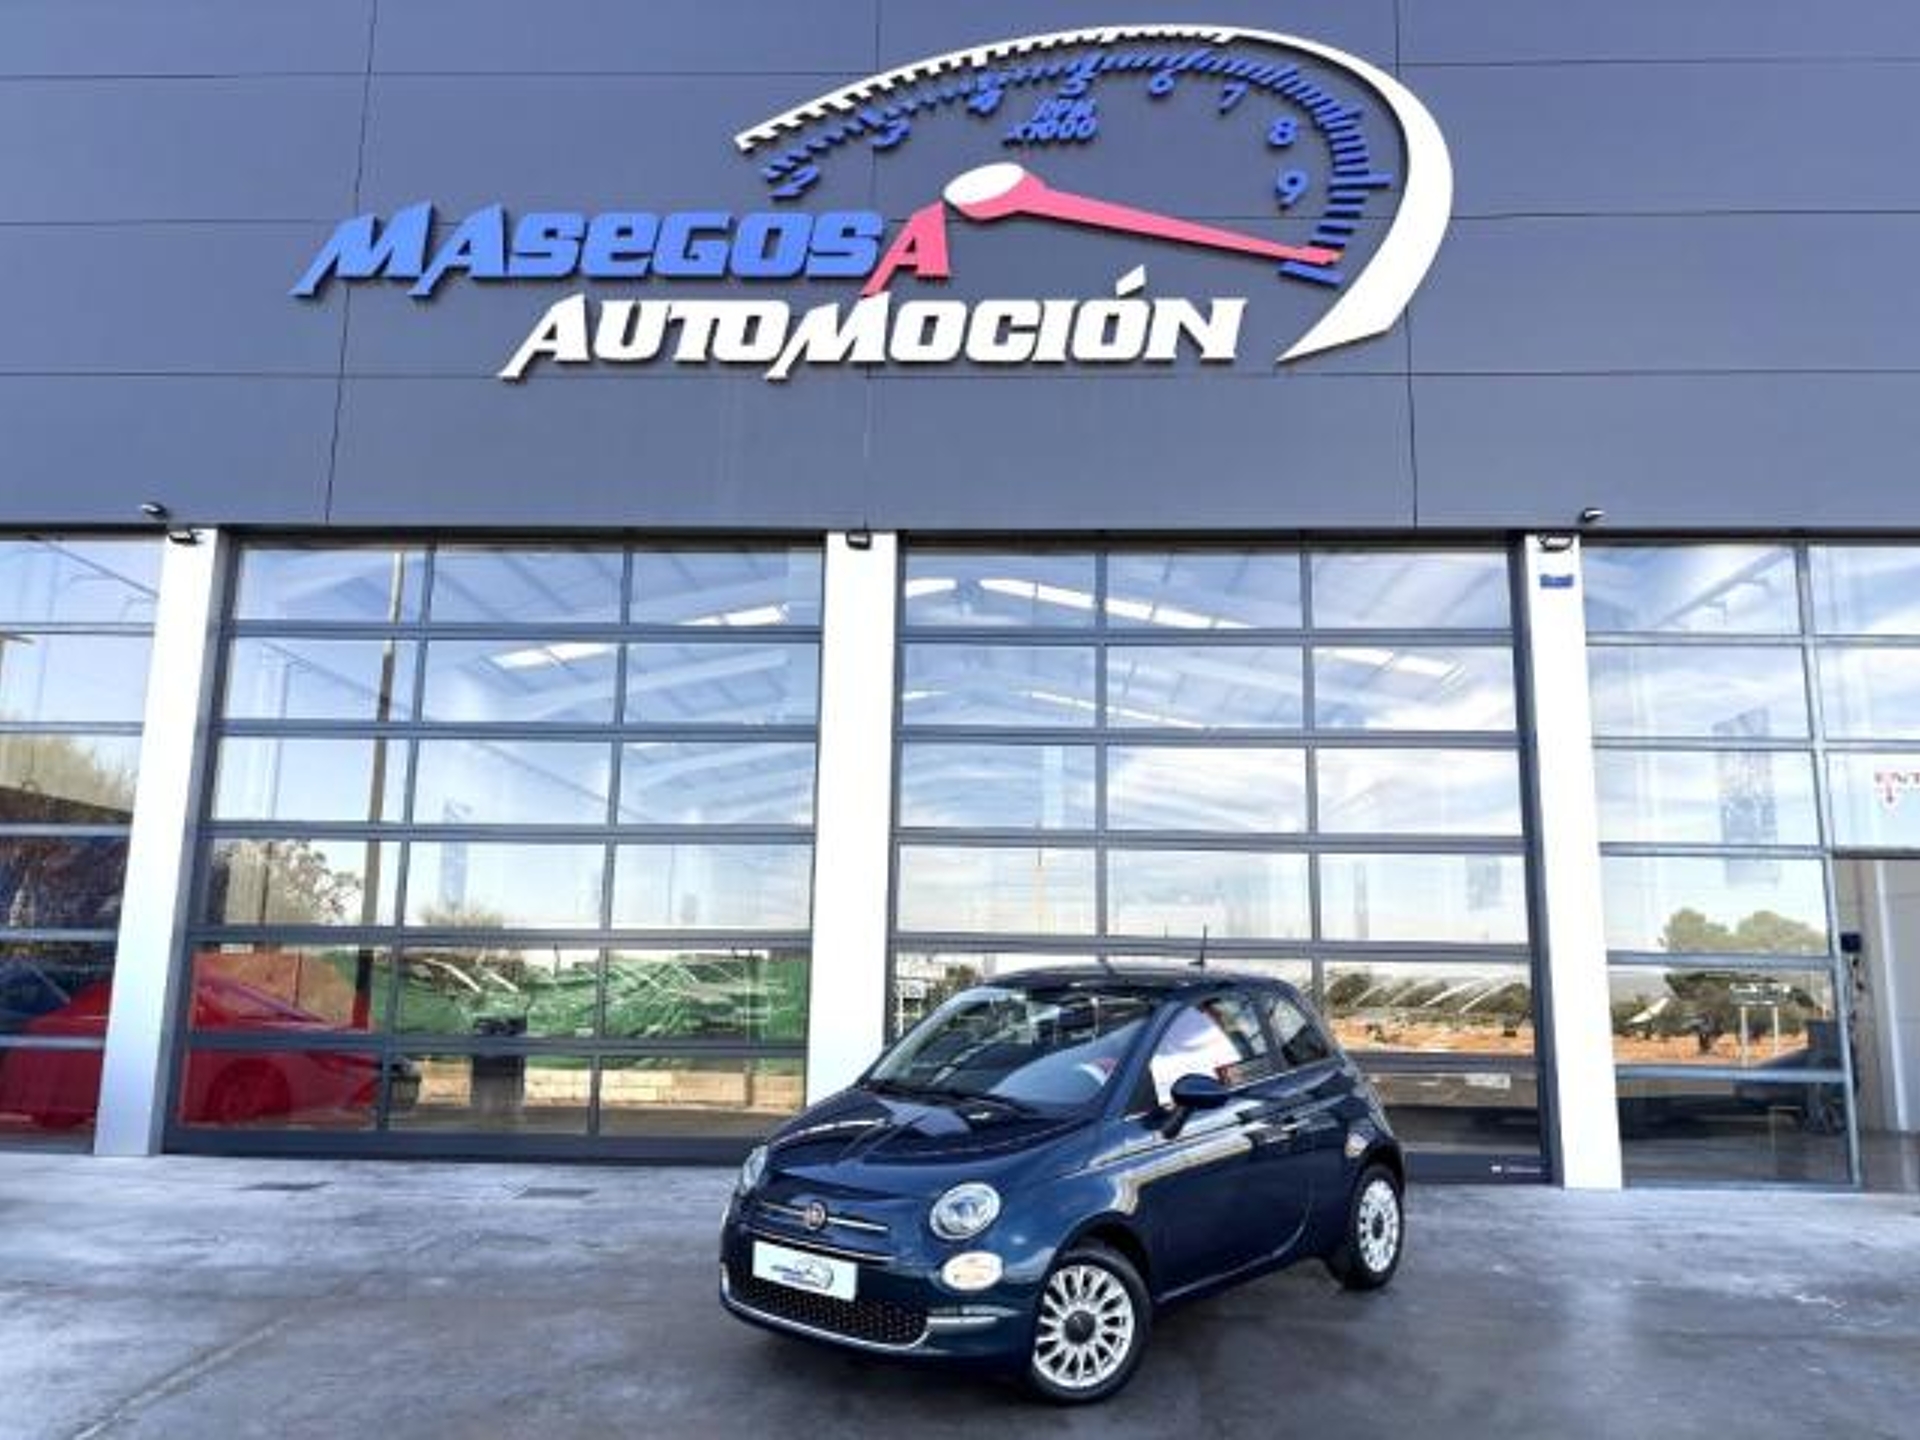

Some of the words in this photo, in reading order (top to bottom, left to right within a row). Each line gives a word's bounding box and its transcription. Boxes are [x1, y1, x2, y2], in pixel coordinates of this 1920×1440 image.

[1150, 67, 1176, 96] 6
[1219, 82, 1248, 112] 7
[1268, 115, 1299, 146] 8
[1277, 167, 1308, 207] 9
[291, 200, 950, 297] MASEGOSA
[499, 265, 1248, 380] AUTOMOCIÓN
